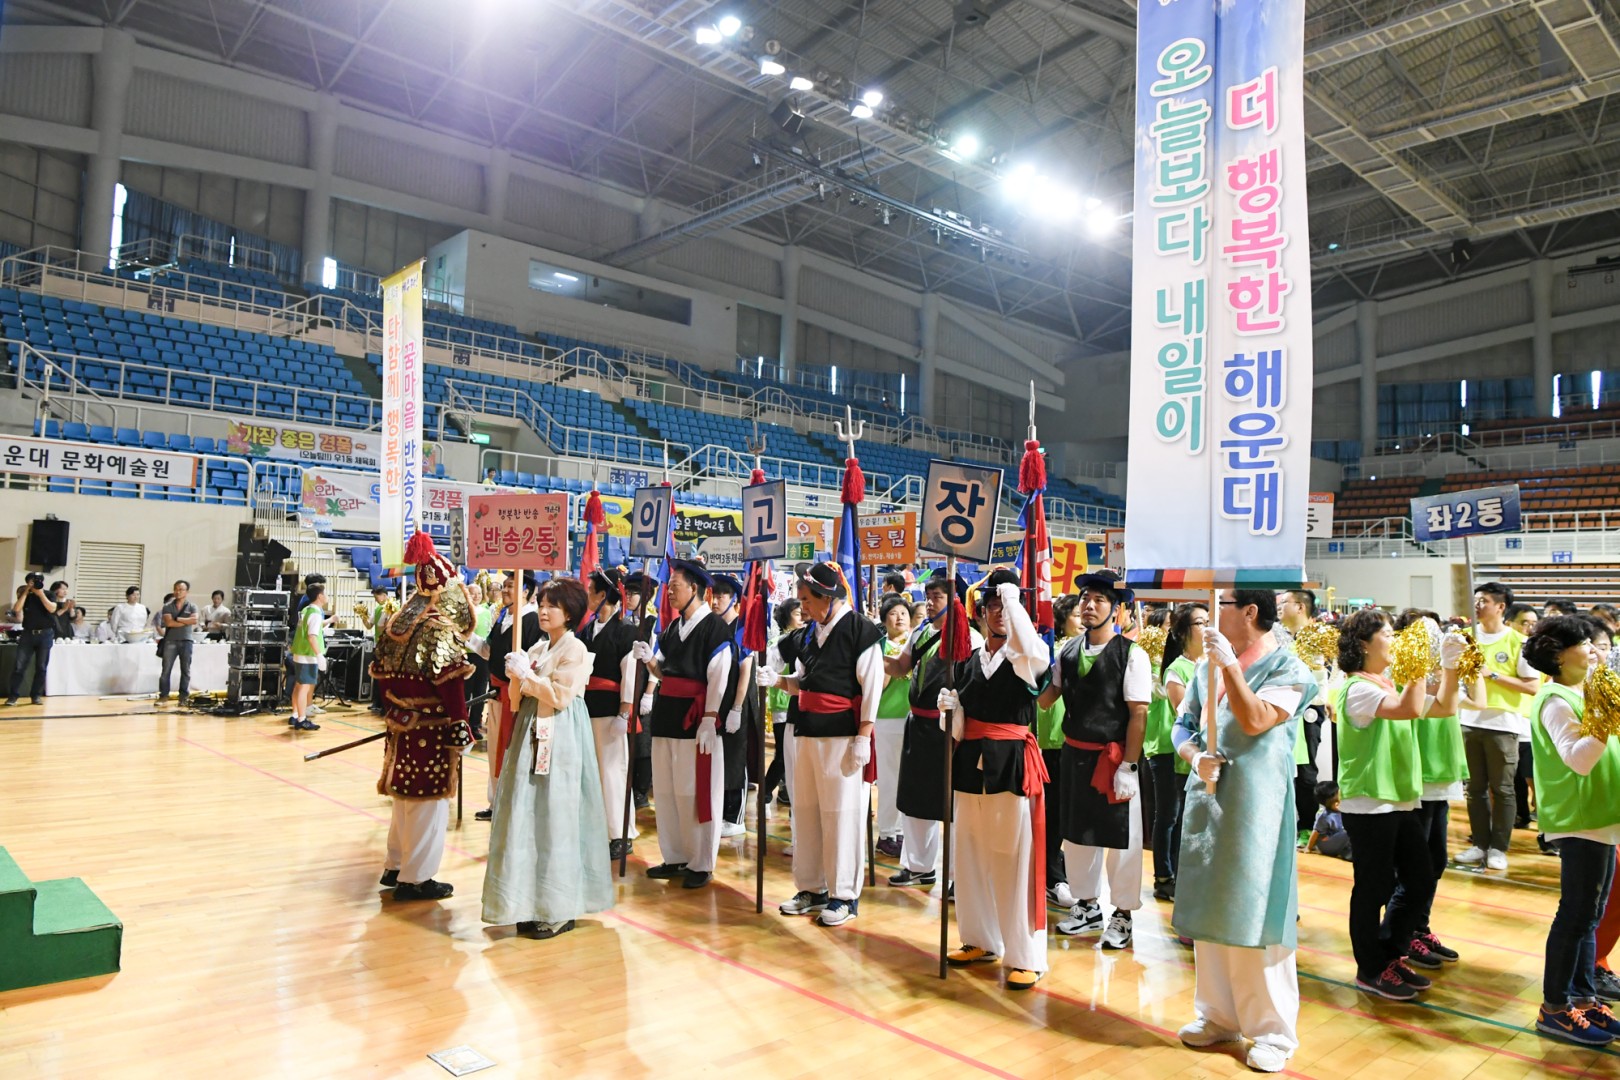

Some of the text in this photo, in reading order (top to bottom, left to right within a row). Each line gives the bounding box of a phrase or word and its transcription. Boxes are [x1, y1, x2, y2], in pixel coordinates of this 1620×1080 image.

[1151, 40, 1211, 451] 오늘보다 내일이
[1219, 70, 1288, 532] 더 행복한 해운대
[240, 424, 277, 447] 가장
[281, 428, 316, 451] 좋은
[319, 432, 353, 455] 경품
[385, 409, 400, 495] 행복한
[3, 445, 170, 479] 운대 문화예술원
[334, 454, 353, 464] 우1동
[355, 456, 376, 467] 체육회
[314, 484, 342, 497] 오라~
[610, 474, 625, 484] 3-3
[629, 477, 646, 488] 2-3
[338, 498, 366, 511] 오라~
[429, 488, 463, 509] 경품
[935, 480, 986, 545] 장
[498, 507, 539, 521] 행복한 반송
[637, 499, 662, 547] 의
[694, 518, 726, 533] 반여2동
[750, 498, 778, 544] 고
[1426, 496, 1503, 533] 좌2동
[452, 517, 462, 558] 충
[483, 526, 556, 554] 반송2동
[887, 529, 906, 548] 팀
